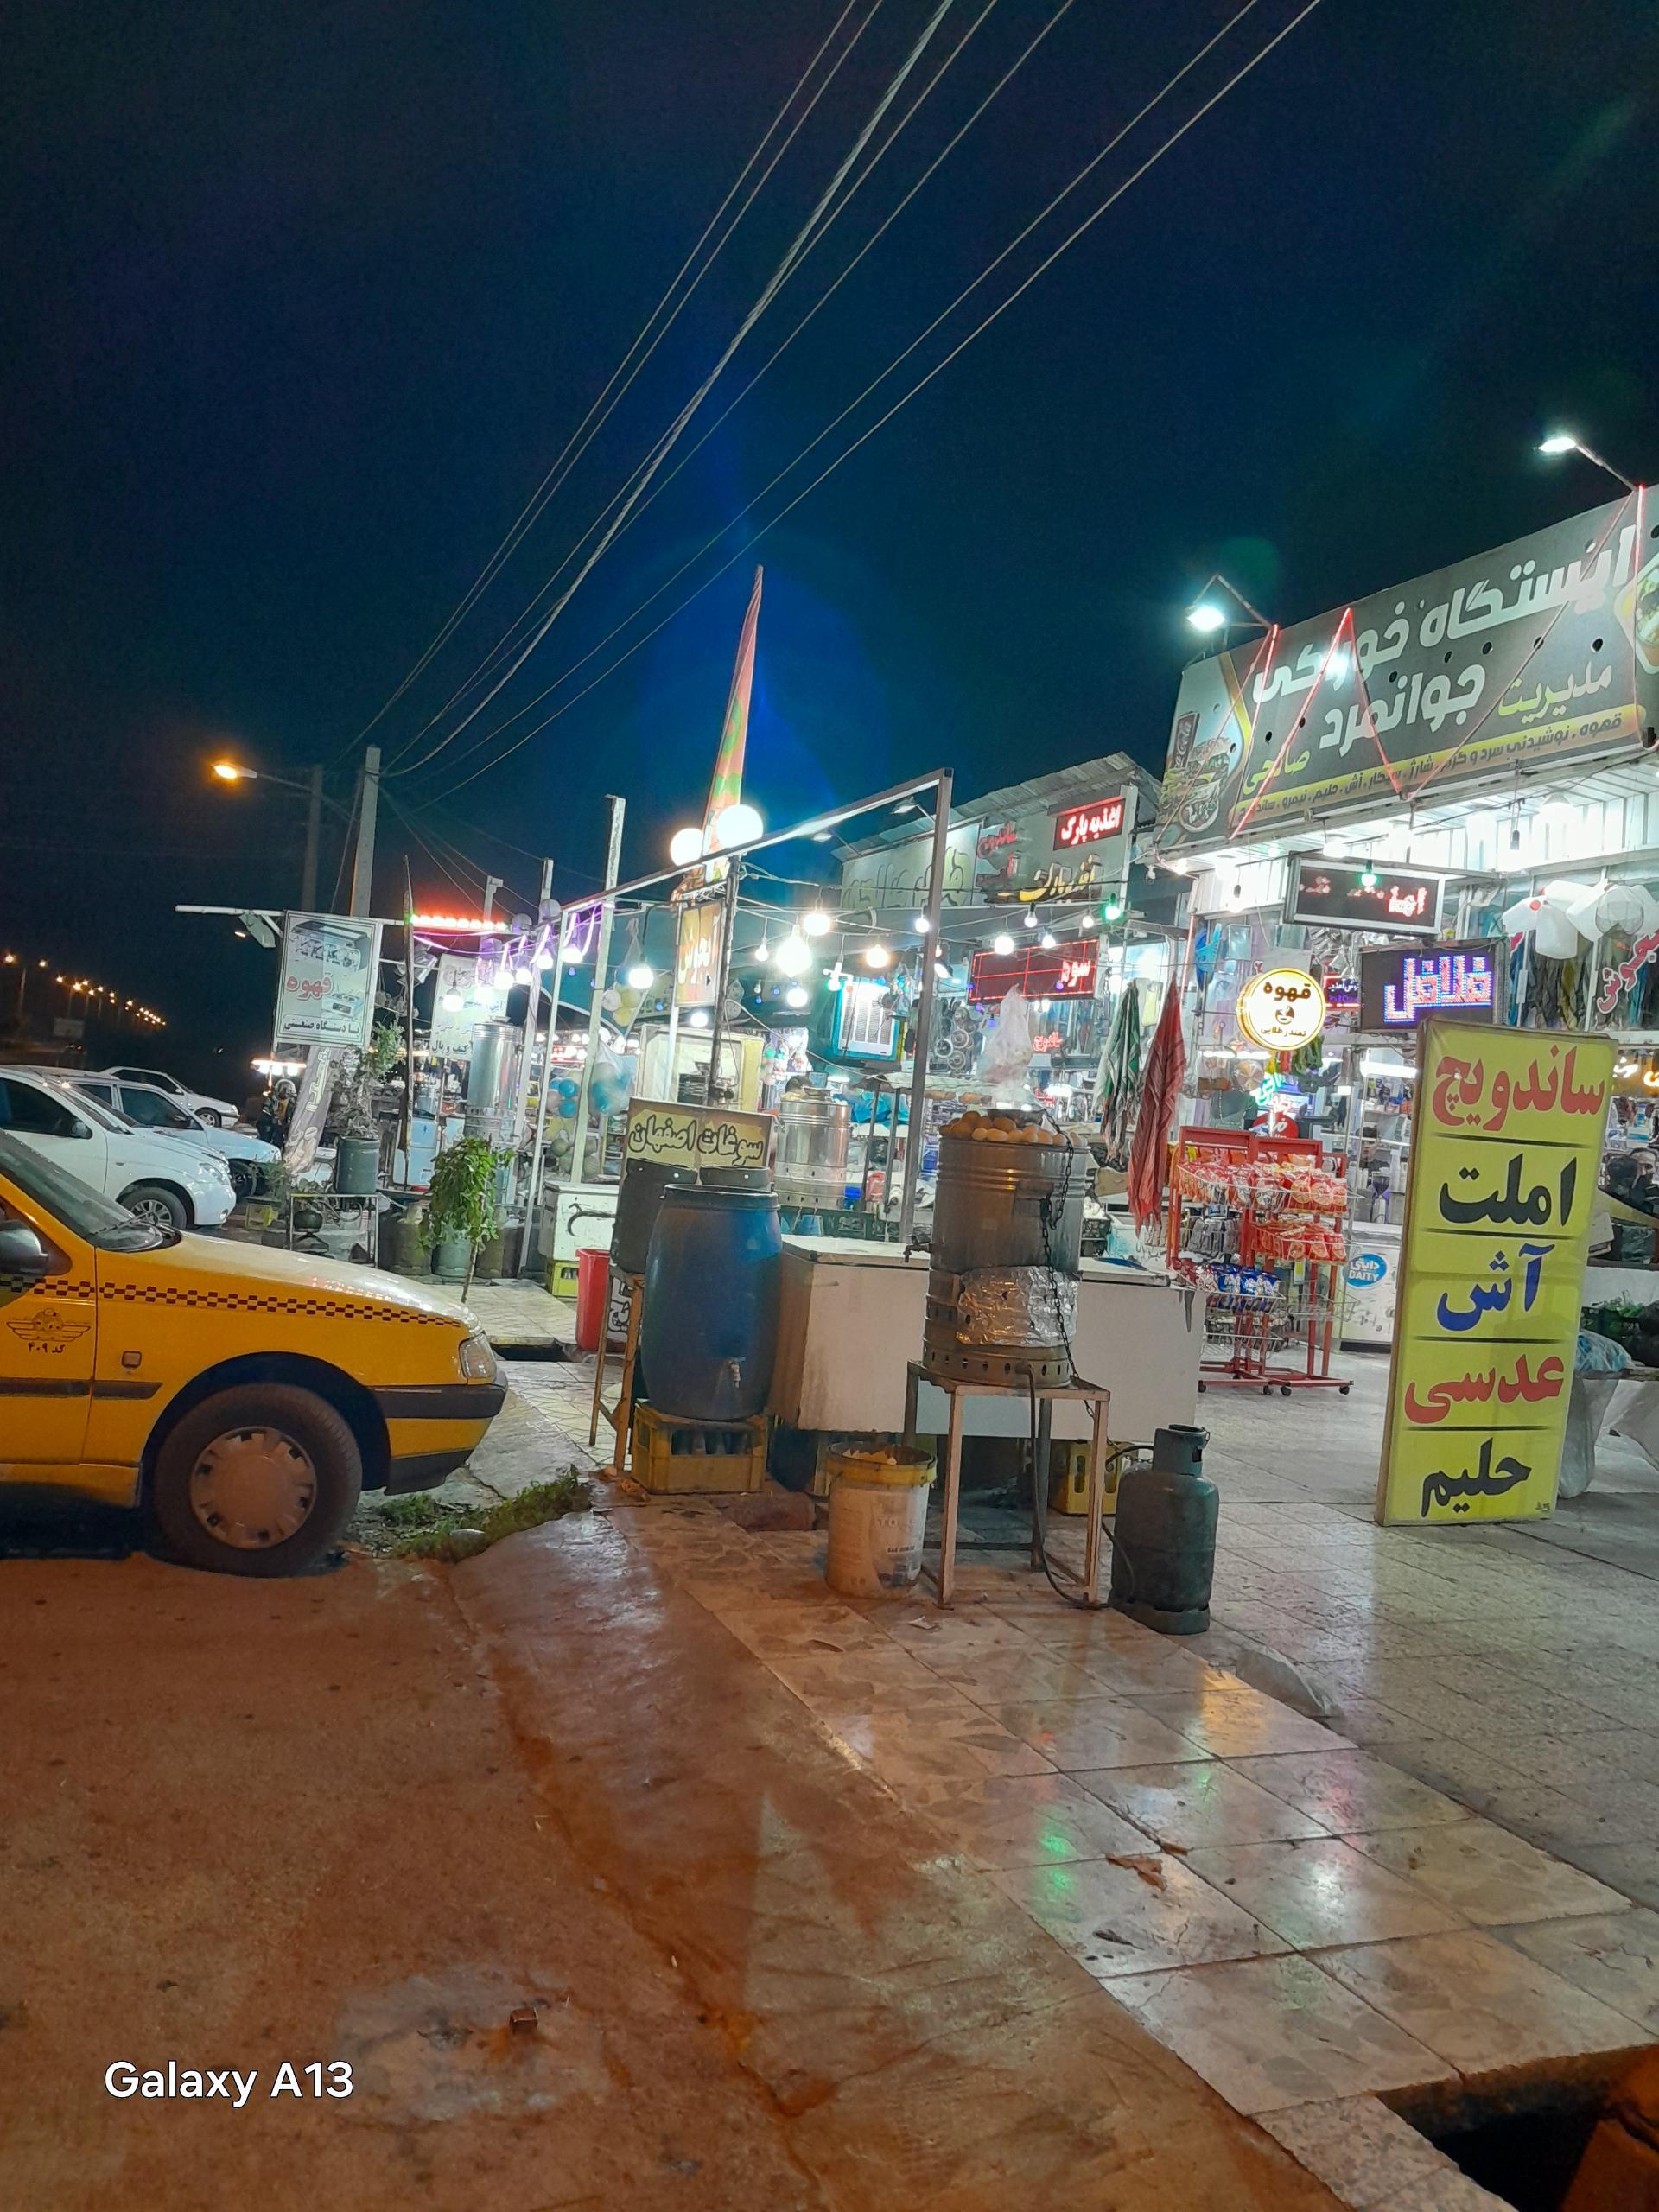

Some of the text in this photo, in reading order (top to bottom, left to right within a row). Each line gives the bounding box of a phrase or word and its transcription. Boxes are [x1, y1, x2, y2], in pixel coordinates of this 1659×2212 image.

[1319, 664, 1486, 757] جوانمرد
[1497, 661, 1612, 724] مدیریت
[1580, 711, 1622, 736] قهوه
[1089, 805, 1122, 839] اغذیه
[286, 972, 333, 1001] قهوه
[1263, 981, 1311, 1002] قهوه
[1383, 955, 1491, 1022] فلافل
[1432, 1044, 1605, 1132] ساندویچ
[627, 1114, 764, 1166] سوغات اصفهان
[1439, 1152, 1577, 1227] املت
[1349, 1270, 1380, 1282] DAITY
[1437, 1243, 1555, 1332] آش
[51, 1344, 66, 1354] کد
[1404, 1353, 1565, 1424] عدسی
[1421, 1437, 1532, 1518] حلیم
